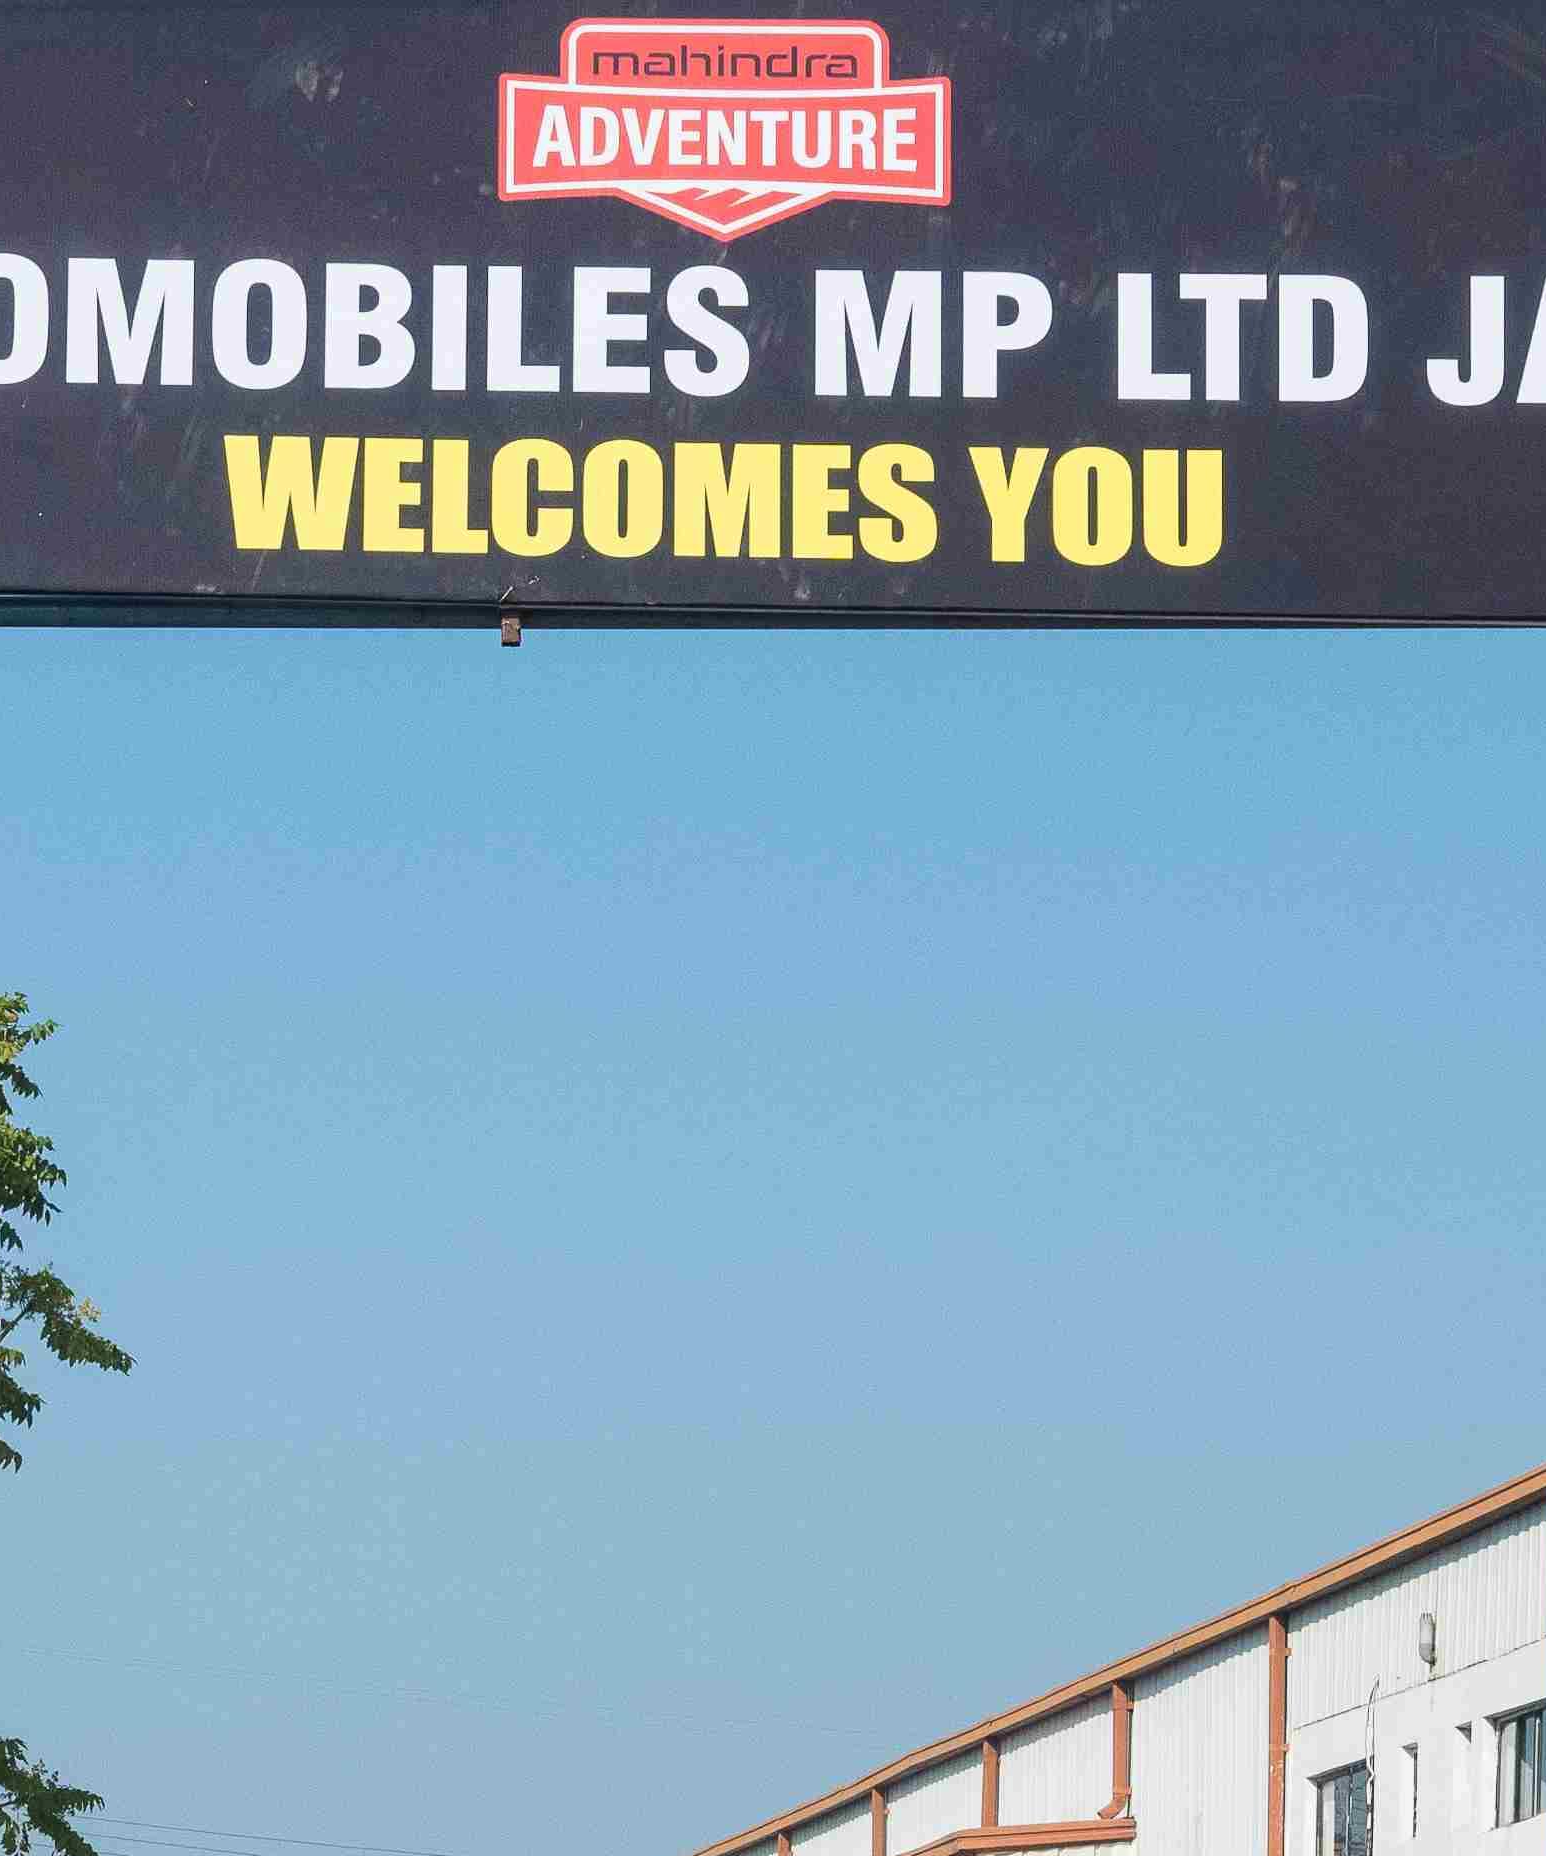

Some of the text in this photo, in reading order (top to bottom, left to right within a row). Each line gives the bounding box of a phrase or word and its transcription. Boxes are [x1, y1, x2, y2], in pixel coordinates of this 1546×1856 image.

[592, 45, 859, 80] mahindra
[532, 104, 918, 172] ADVENTURE
[815, 270, 1052, 398] MP
[1118, 273, 1368, 401] LTD
[224, 432, 1223, 567] WELCOMES YOU
